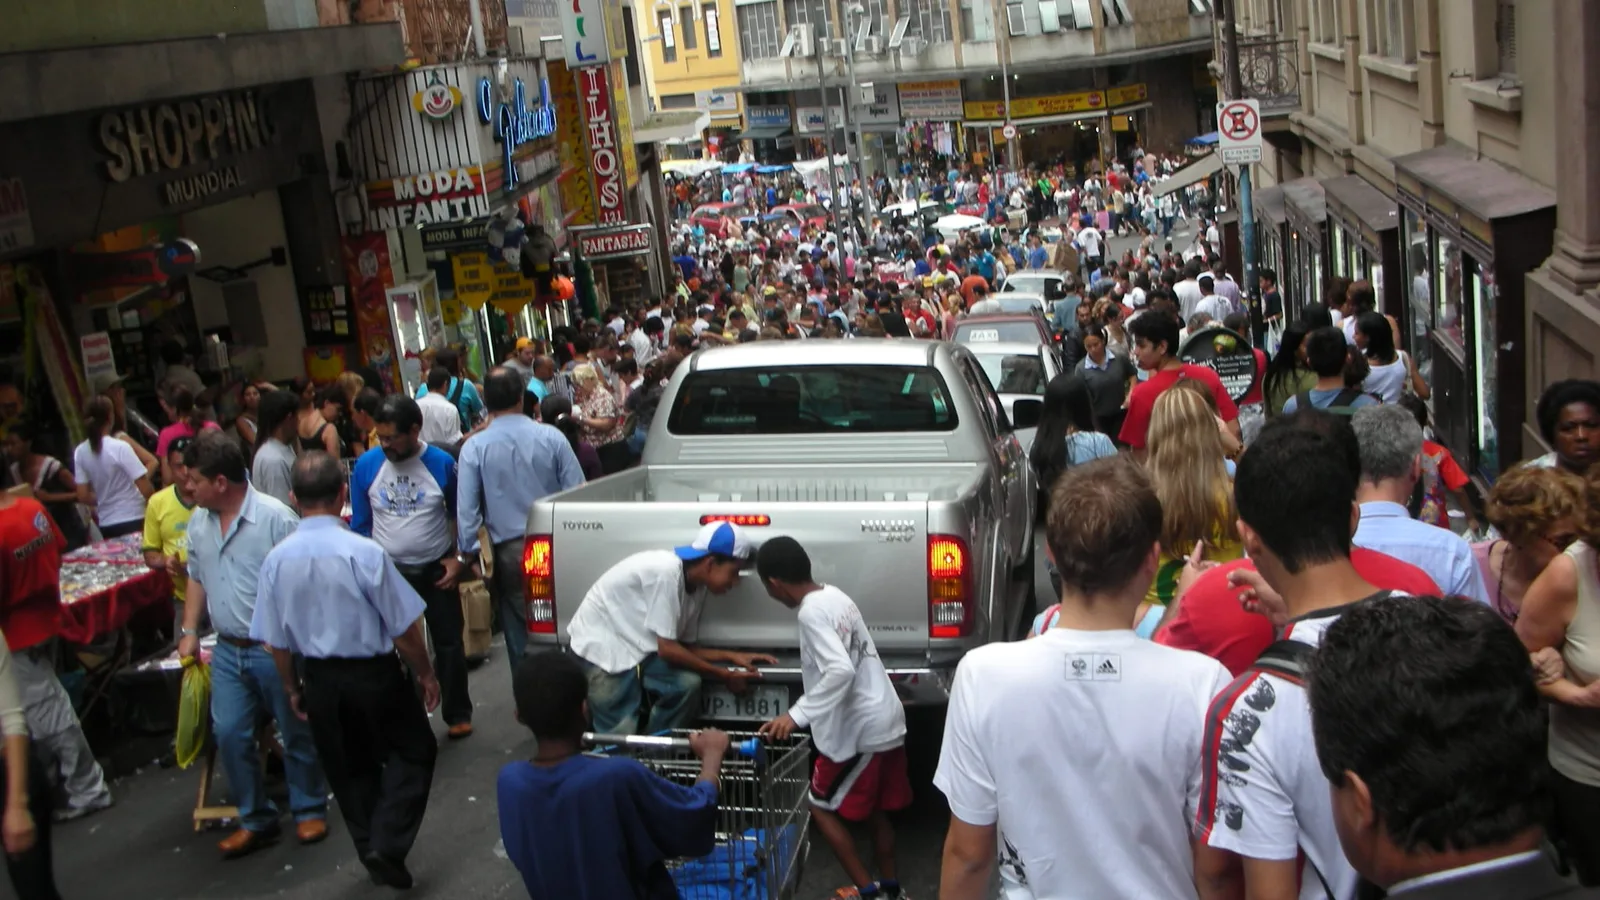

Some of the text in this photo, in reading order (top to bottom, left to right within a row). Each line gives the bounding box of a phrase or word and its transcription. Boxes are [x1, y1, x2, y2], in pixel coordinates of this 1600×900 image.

[165, 165, 247, 205] MUNDIAL
[392, 169, 475, 201] MODA
[369, 193, 490, 231] INFANTIL
[426, 228, 457, 243] MODA
[582, 233, 649, 254] FANTASIAS
[562, 520, 604, 531] TOYOTA
